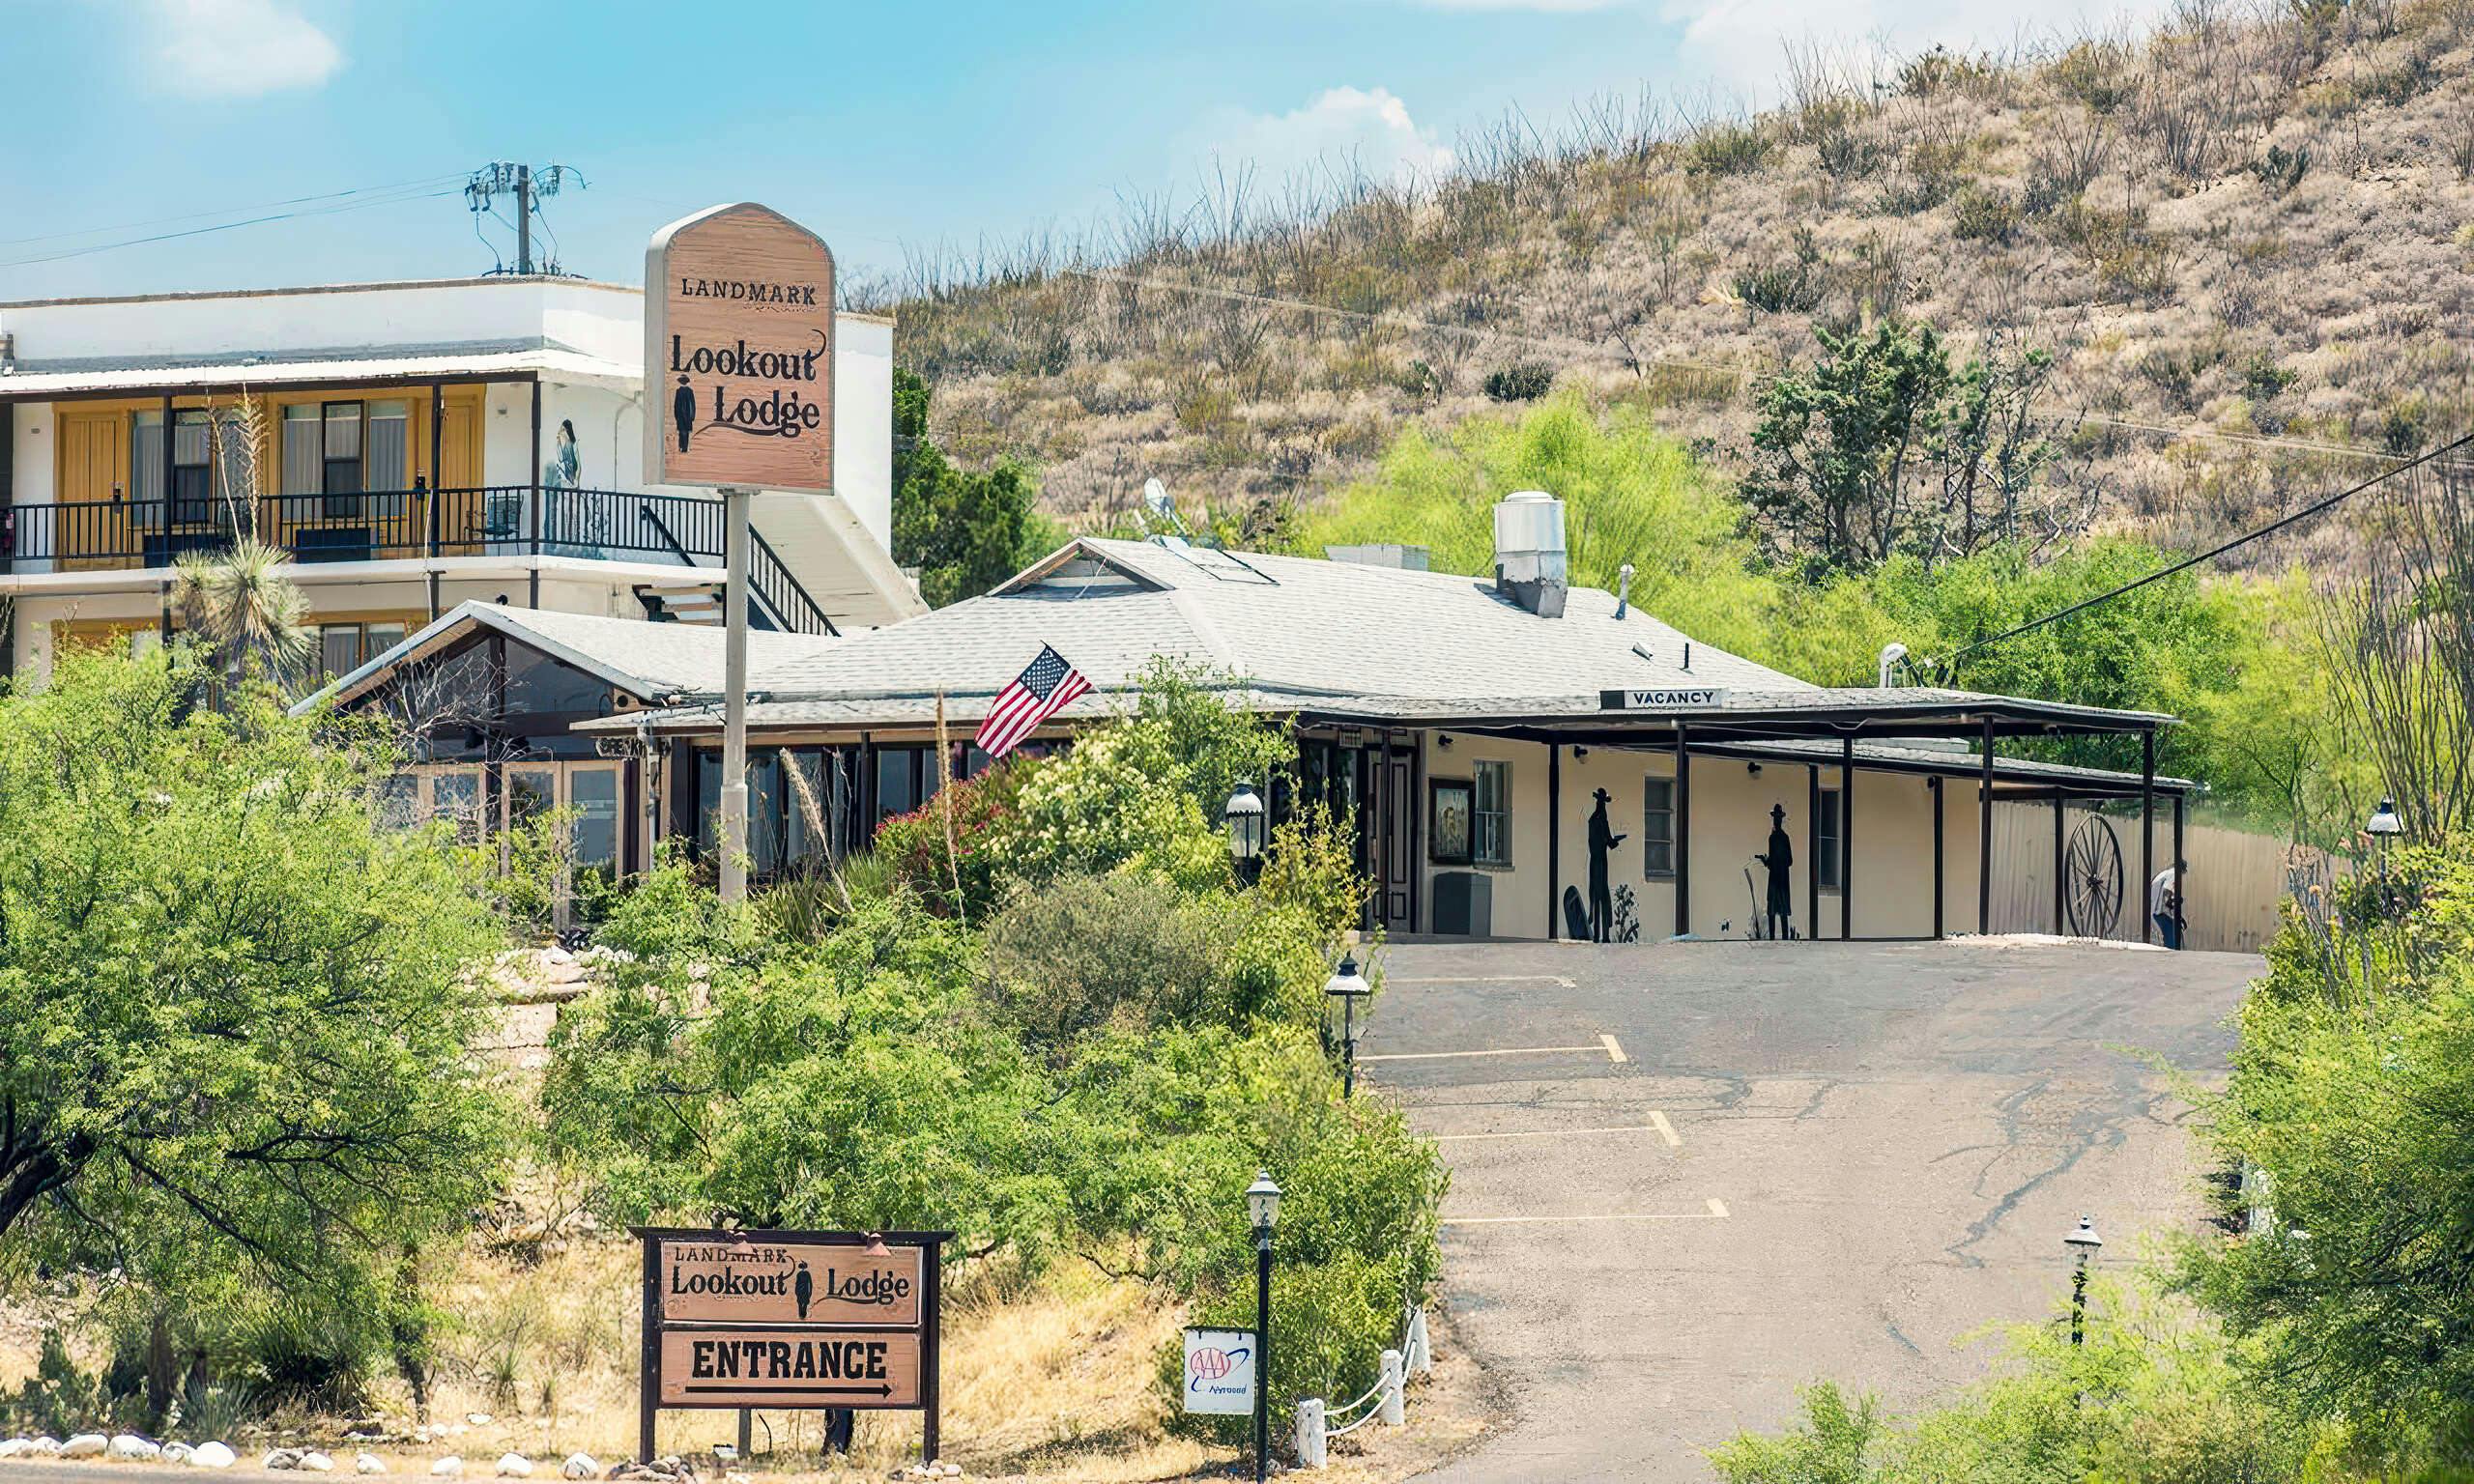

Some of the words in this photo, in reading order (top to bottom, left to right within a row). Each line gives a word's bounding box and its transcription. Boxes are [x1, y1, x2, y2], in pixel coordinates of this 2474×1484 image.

[681, 278, 817, 305] LANDMARK
[671, 328, 827, 381] Lookout
[694, 385, 820, 438] Lodge
[1633, 691, 1714, 704] VACANCY
[671, 1256, 795, 1296] Lookout
[814, 1268, 909, 1304] Lodge
[691, 1341, 887, 1380] ENTRANCE
[1193, 1348, 1227, 1380] AAA
